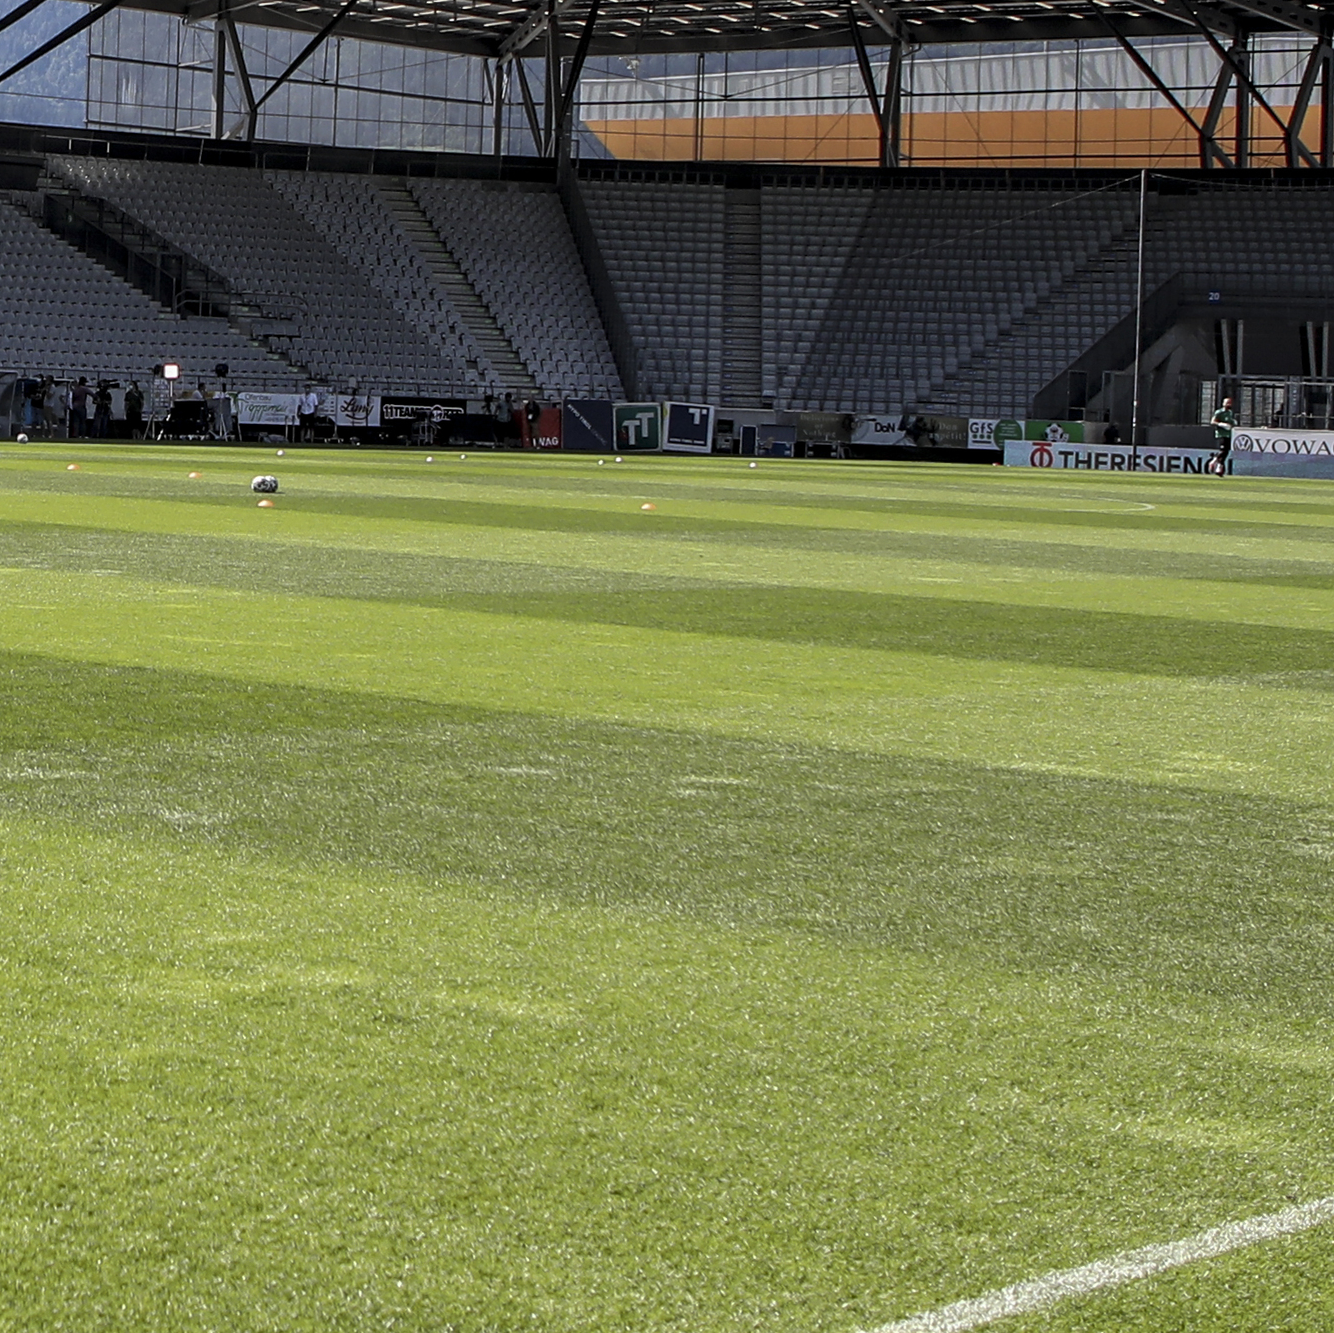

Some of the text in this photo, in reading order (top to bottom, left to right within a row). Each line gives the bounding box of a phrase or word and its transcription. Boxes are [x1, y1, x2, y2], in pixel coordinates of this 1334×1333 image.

[1209, 292, 1220, 301] 20
[969, 422, 994, 434] GfS
[1254, 438, 1332, 456] VOWA
